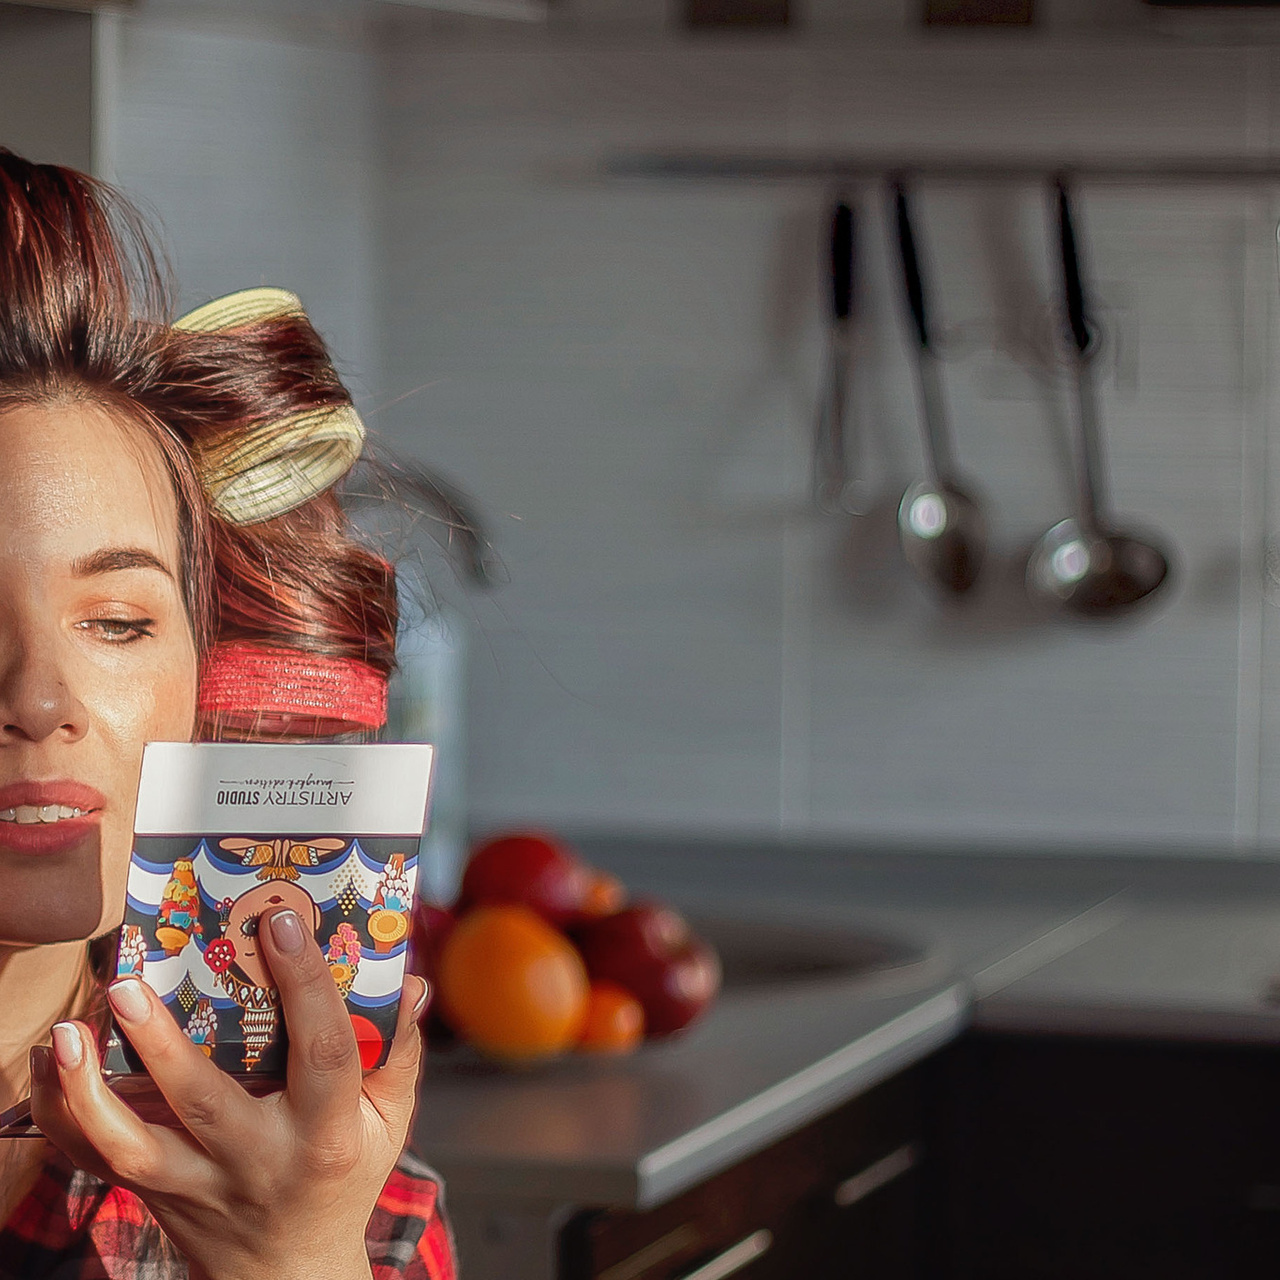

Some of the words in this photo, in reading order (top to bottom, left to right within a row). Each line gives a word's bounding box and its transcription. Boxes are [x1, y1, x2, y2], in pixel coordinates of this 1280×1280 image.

[243, 777, 287, 790] edition
[216, 790, 260, 806] STUDIO
[263, 790, 353, 807] ARTISTRY
